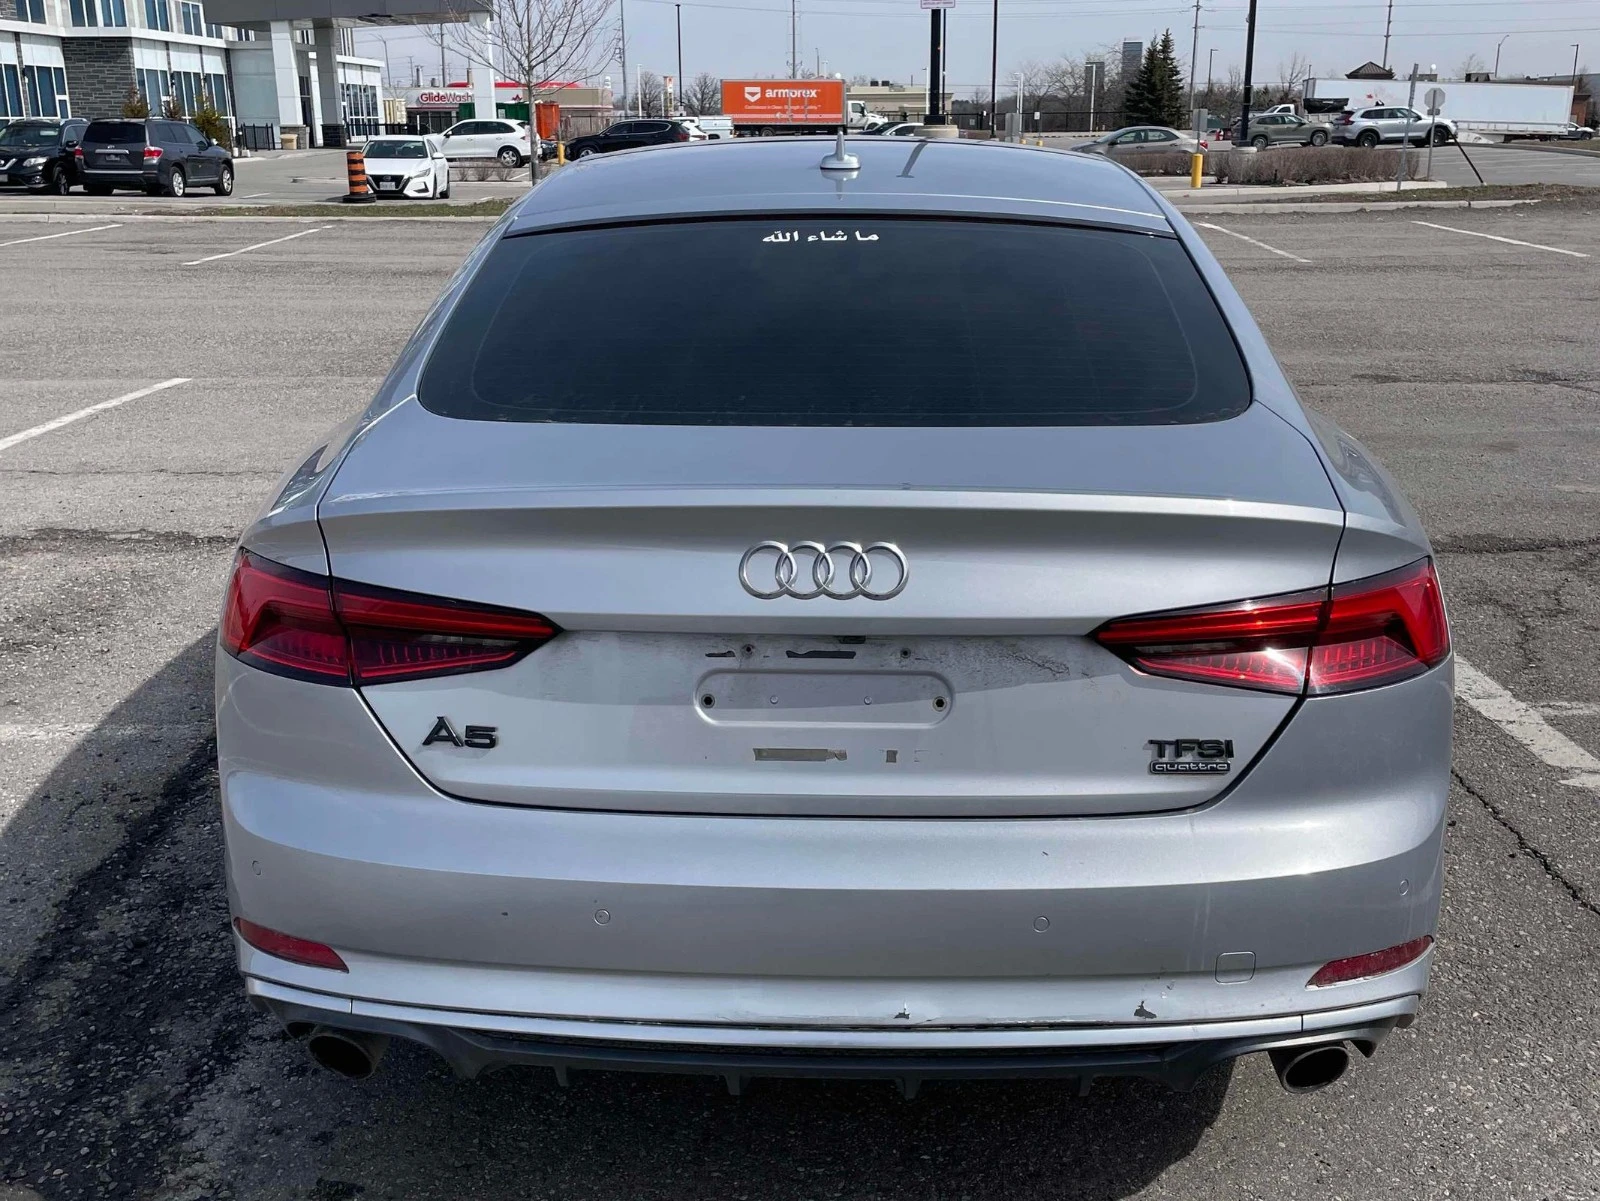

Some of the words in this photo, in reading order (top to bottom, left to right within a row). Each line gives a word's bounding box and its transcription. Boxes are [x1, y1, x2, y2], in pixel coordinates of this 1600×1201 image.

[420, 92, 473, 103] GlideWash
[765, 89, 817, 98] armorex
[762, 230, 799, 242] الله
[807, 230, 847, 242] شاء
[855, 230, 880, 241] ما
[422, 716, 498, 749] A5
[1148, 738, 1235, 759] TFSI
[1155, 762, 1228, 772] quattro
